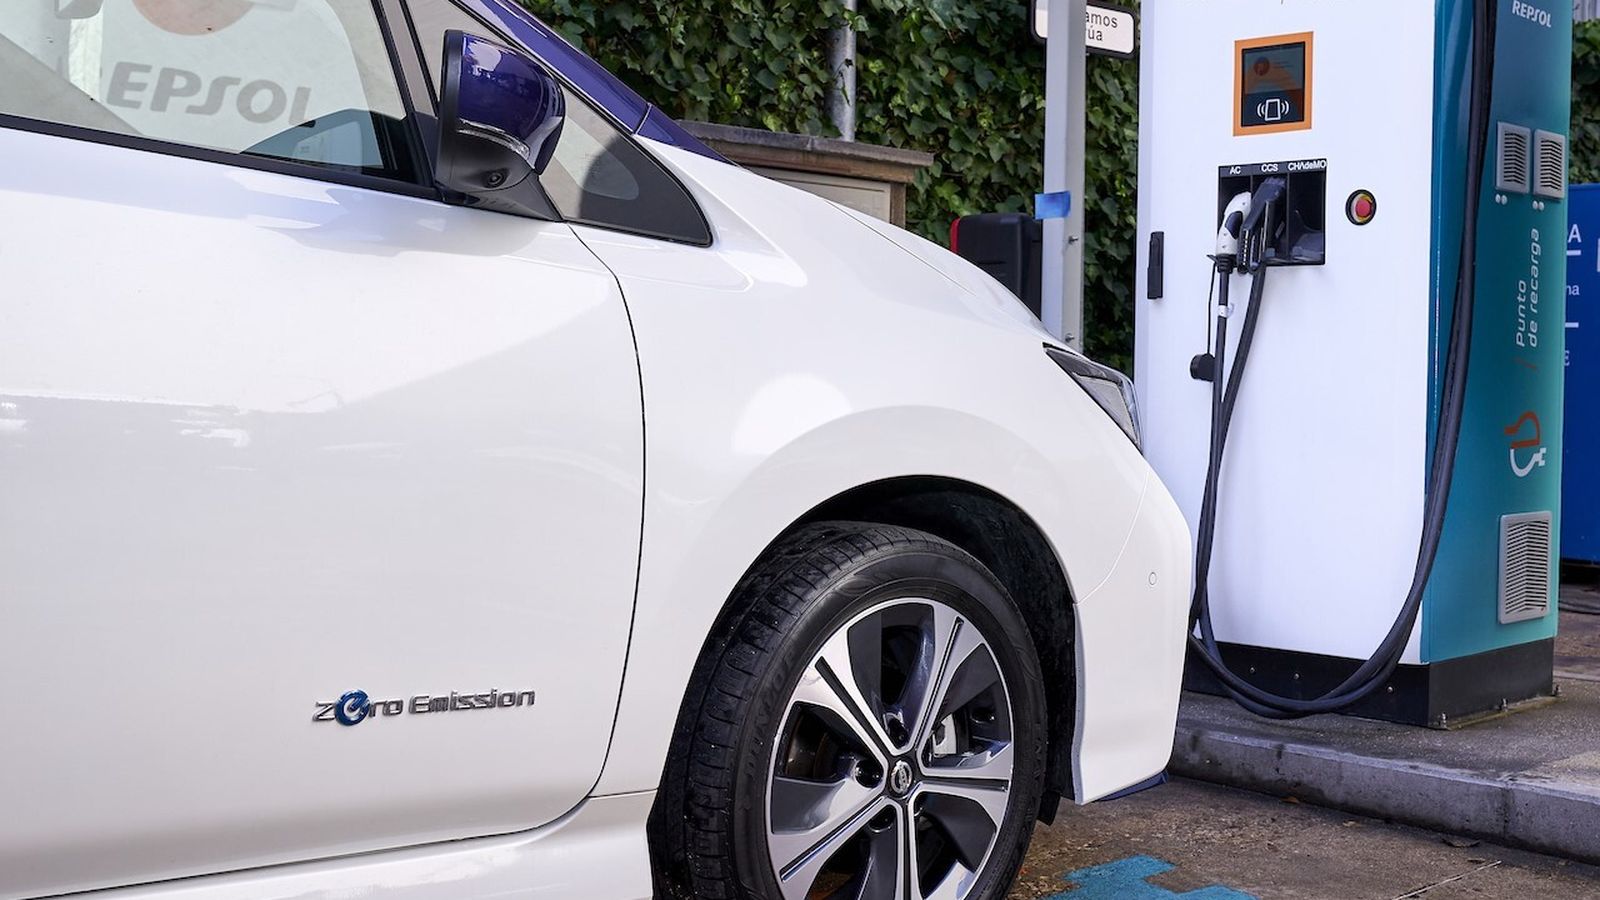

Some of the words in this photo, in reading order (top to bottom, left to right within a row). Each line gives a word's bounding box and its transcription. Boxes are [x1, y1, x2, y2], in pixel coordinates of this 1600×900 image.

[1511, 0, 1552, 28] REPSOL
[1229, 166, 1241, 175] AC
[1261, 163, 1279, 173] CCS
[1567, 223, 1582, 243] A
[1529, 228, 1542, 314] recarga
[1515, 280, 1527, 348] Punto
[1527, 320, 1538, 348] de
[408, 688, 536, 714] Emission
